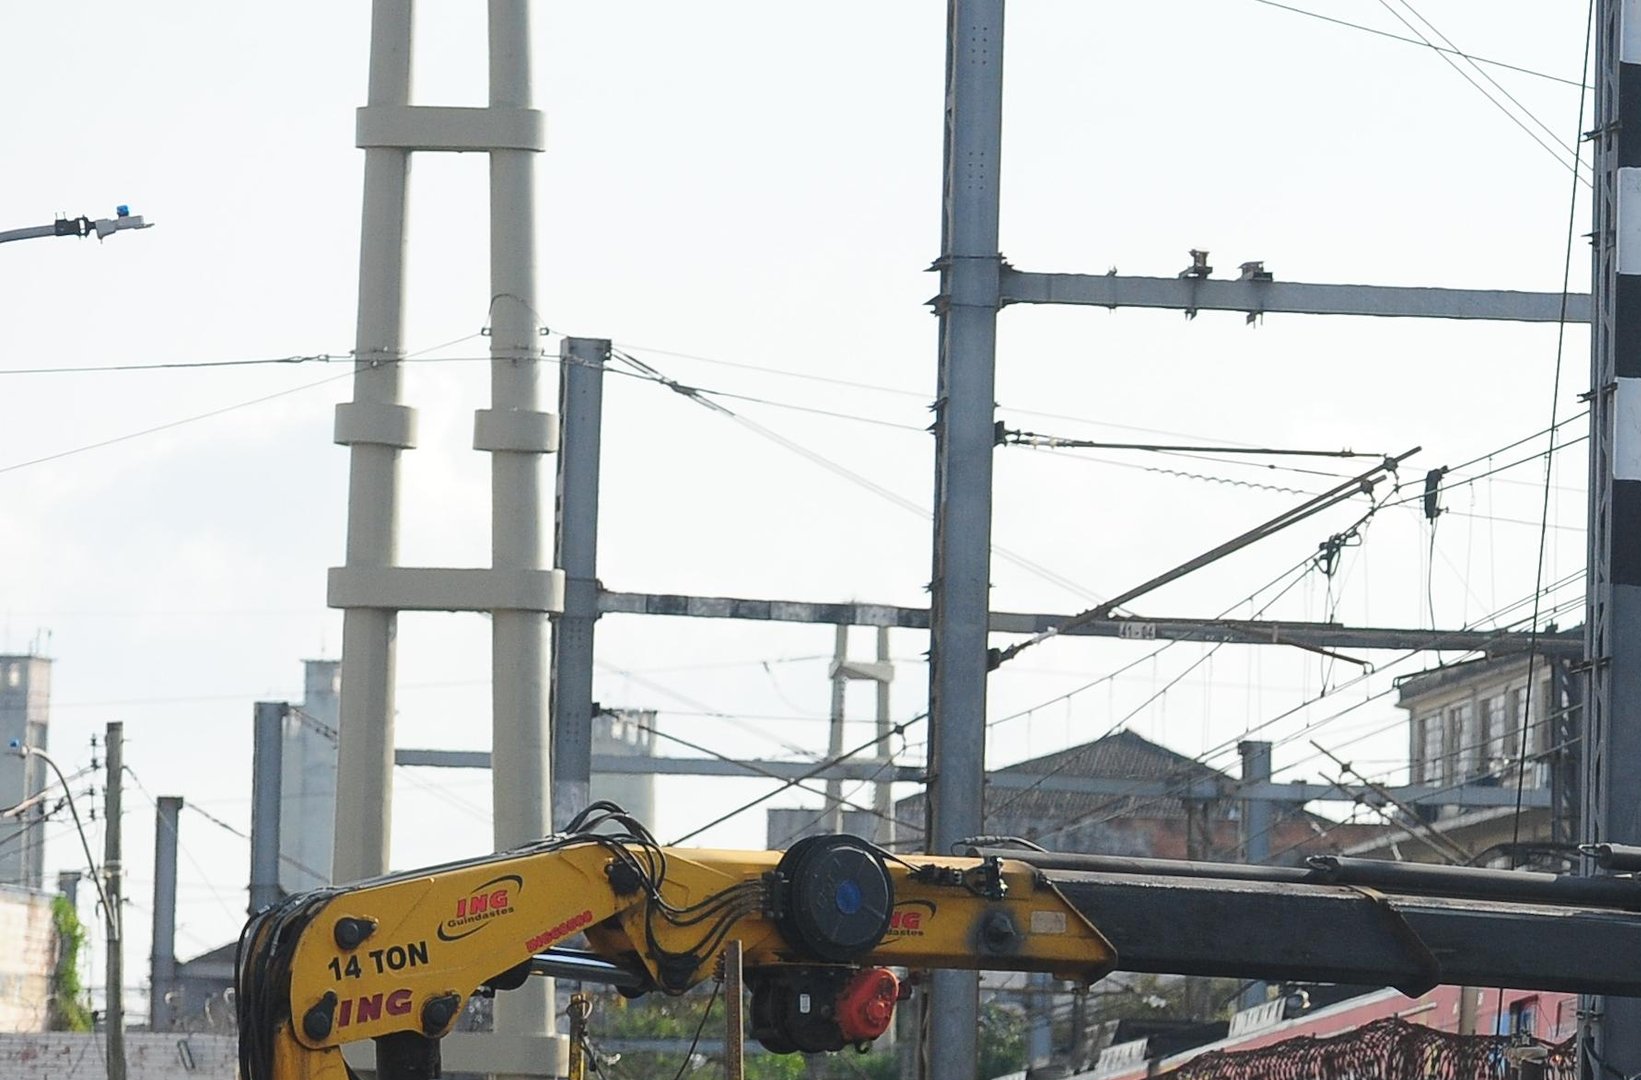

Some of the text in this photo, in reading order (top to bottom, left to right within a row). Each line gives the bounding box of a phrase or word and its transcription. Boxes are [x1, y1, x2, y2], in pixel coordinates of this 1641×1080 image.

[447, 906, 514, 928] Guindastes
[456, 889, 509, 918] ING
[328, 940, 429, 981] 14 TON
[338, 988, 414, 1027] ING
